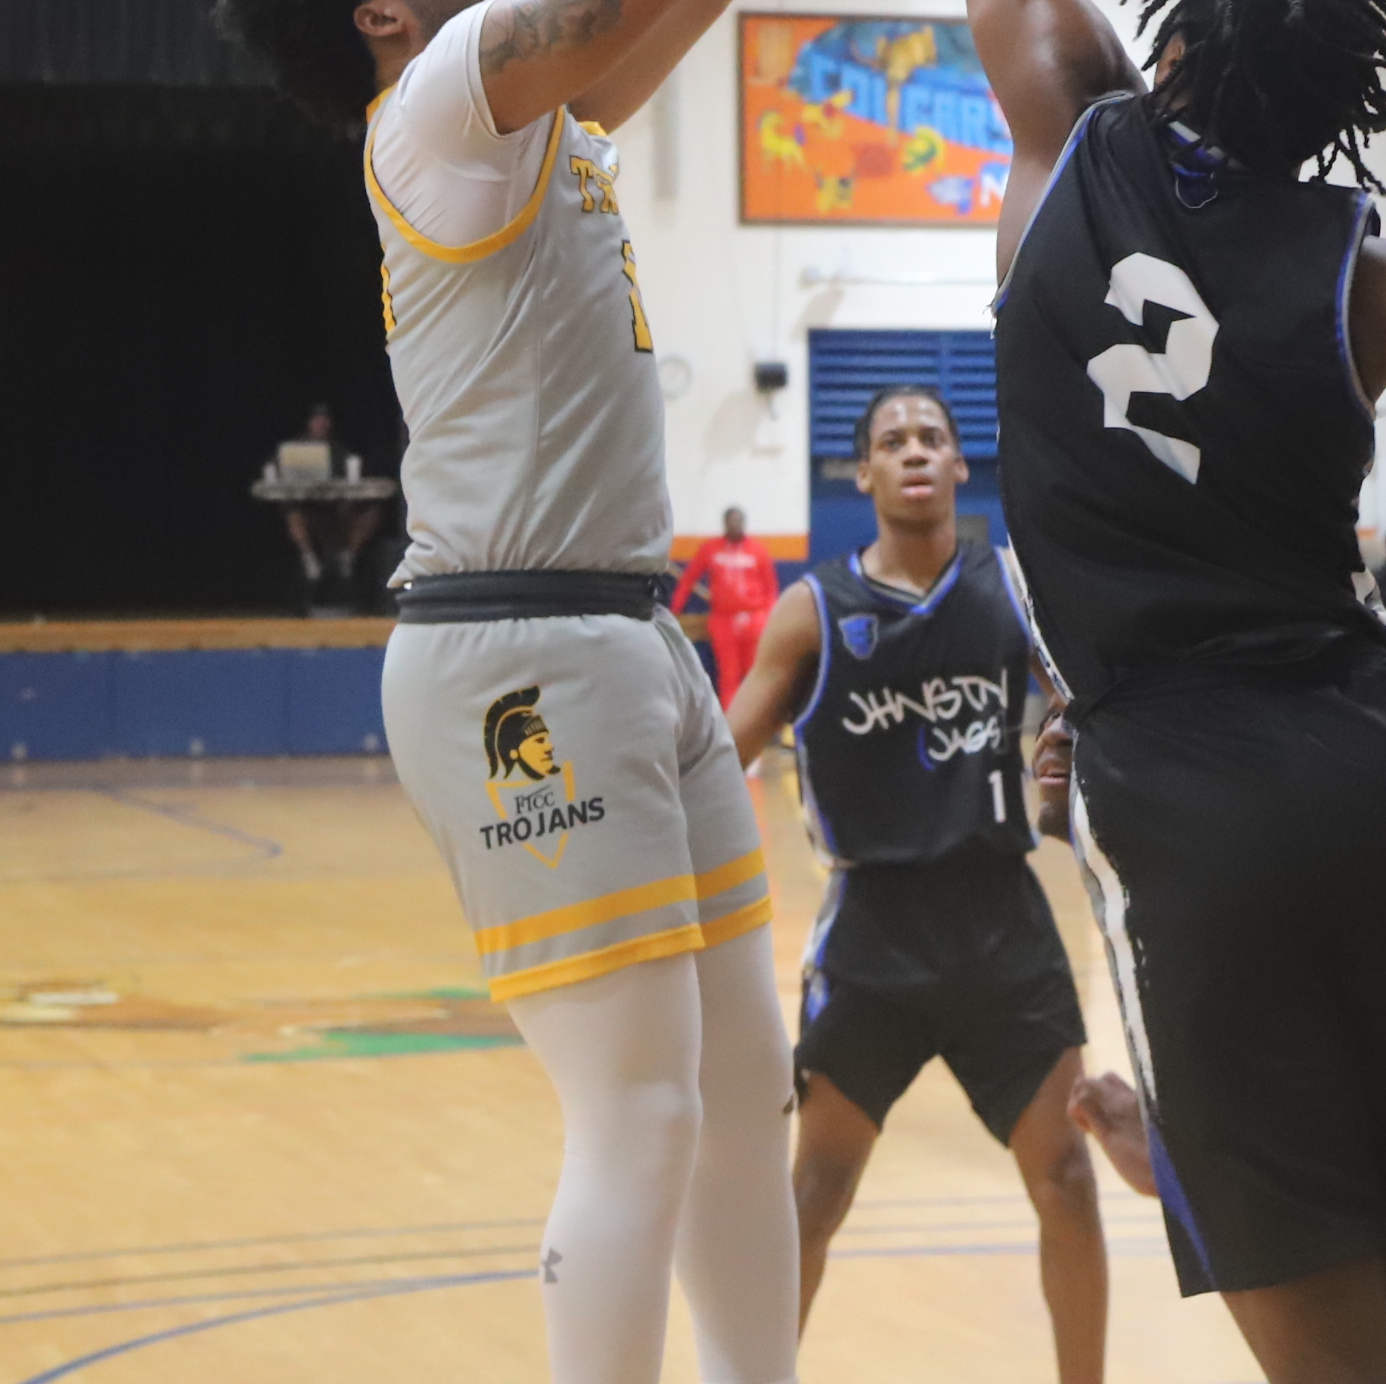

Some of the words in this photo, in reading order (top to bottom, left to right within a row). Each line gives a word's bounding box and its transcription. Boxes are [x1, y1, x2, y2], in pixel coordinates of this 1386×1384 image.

[1086, 251, 1220, 485] 2
[479, 796, 606, 850] TROJANS
[515, 784, 556, 815] FTCC
[988, 770, 1007, 823] 1
